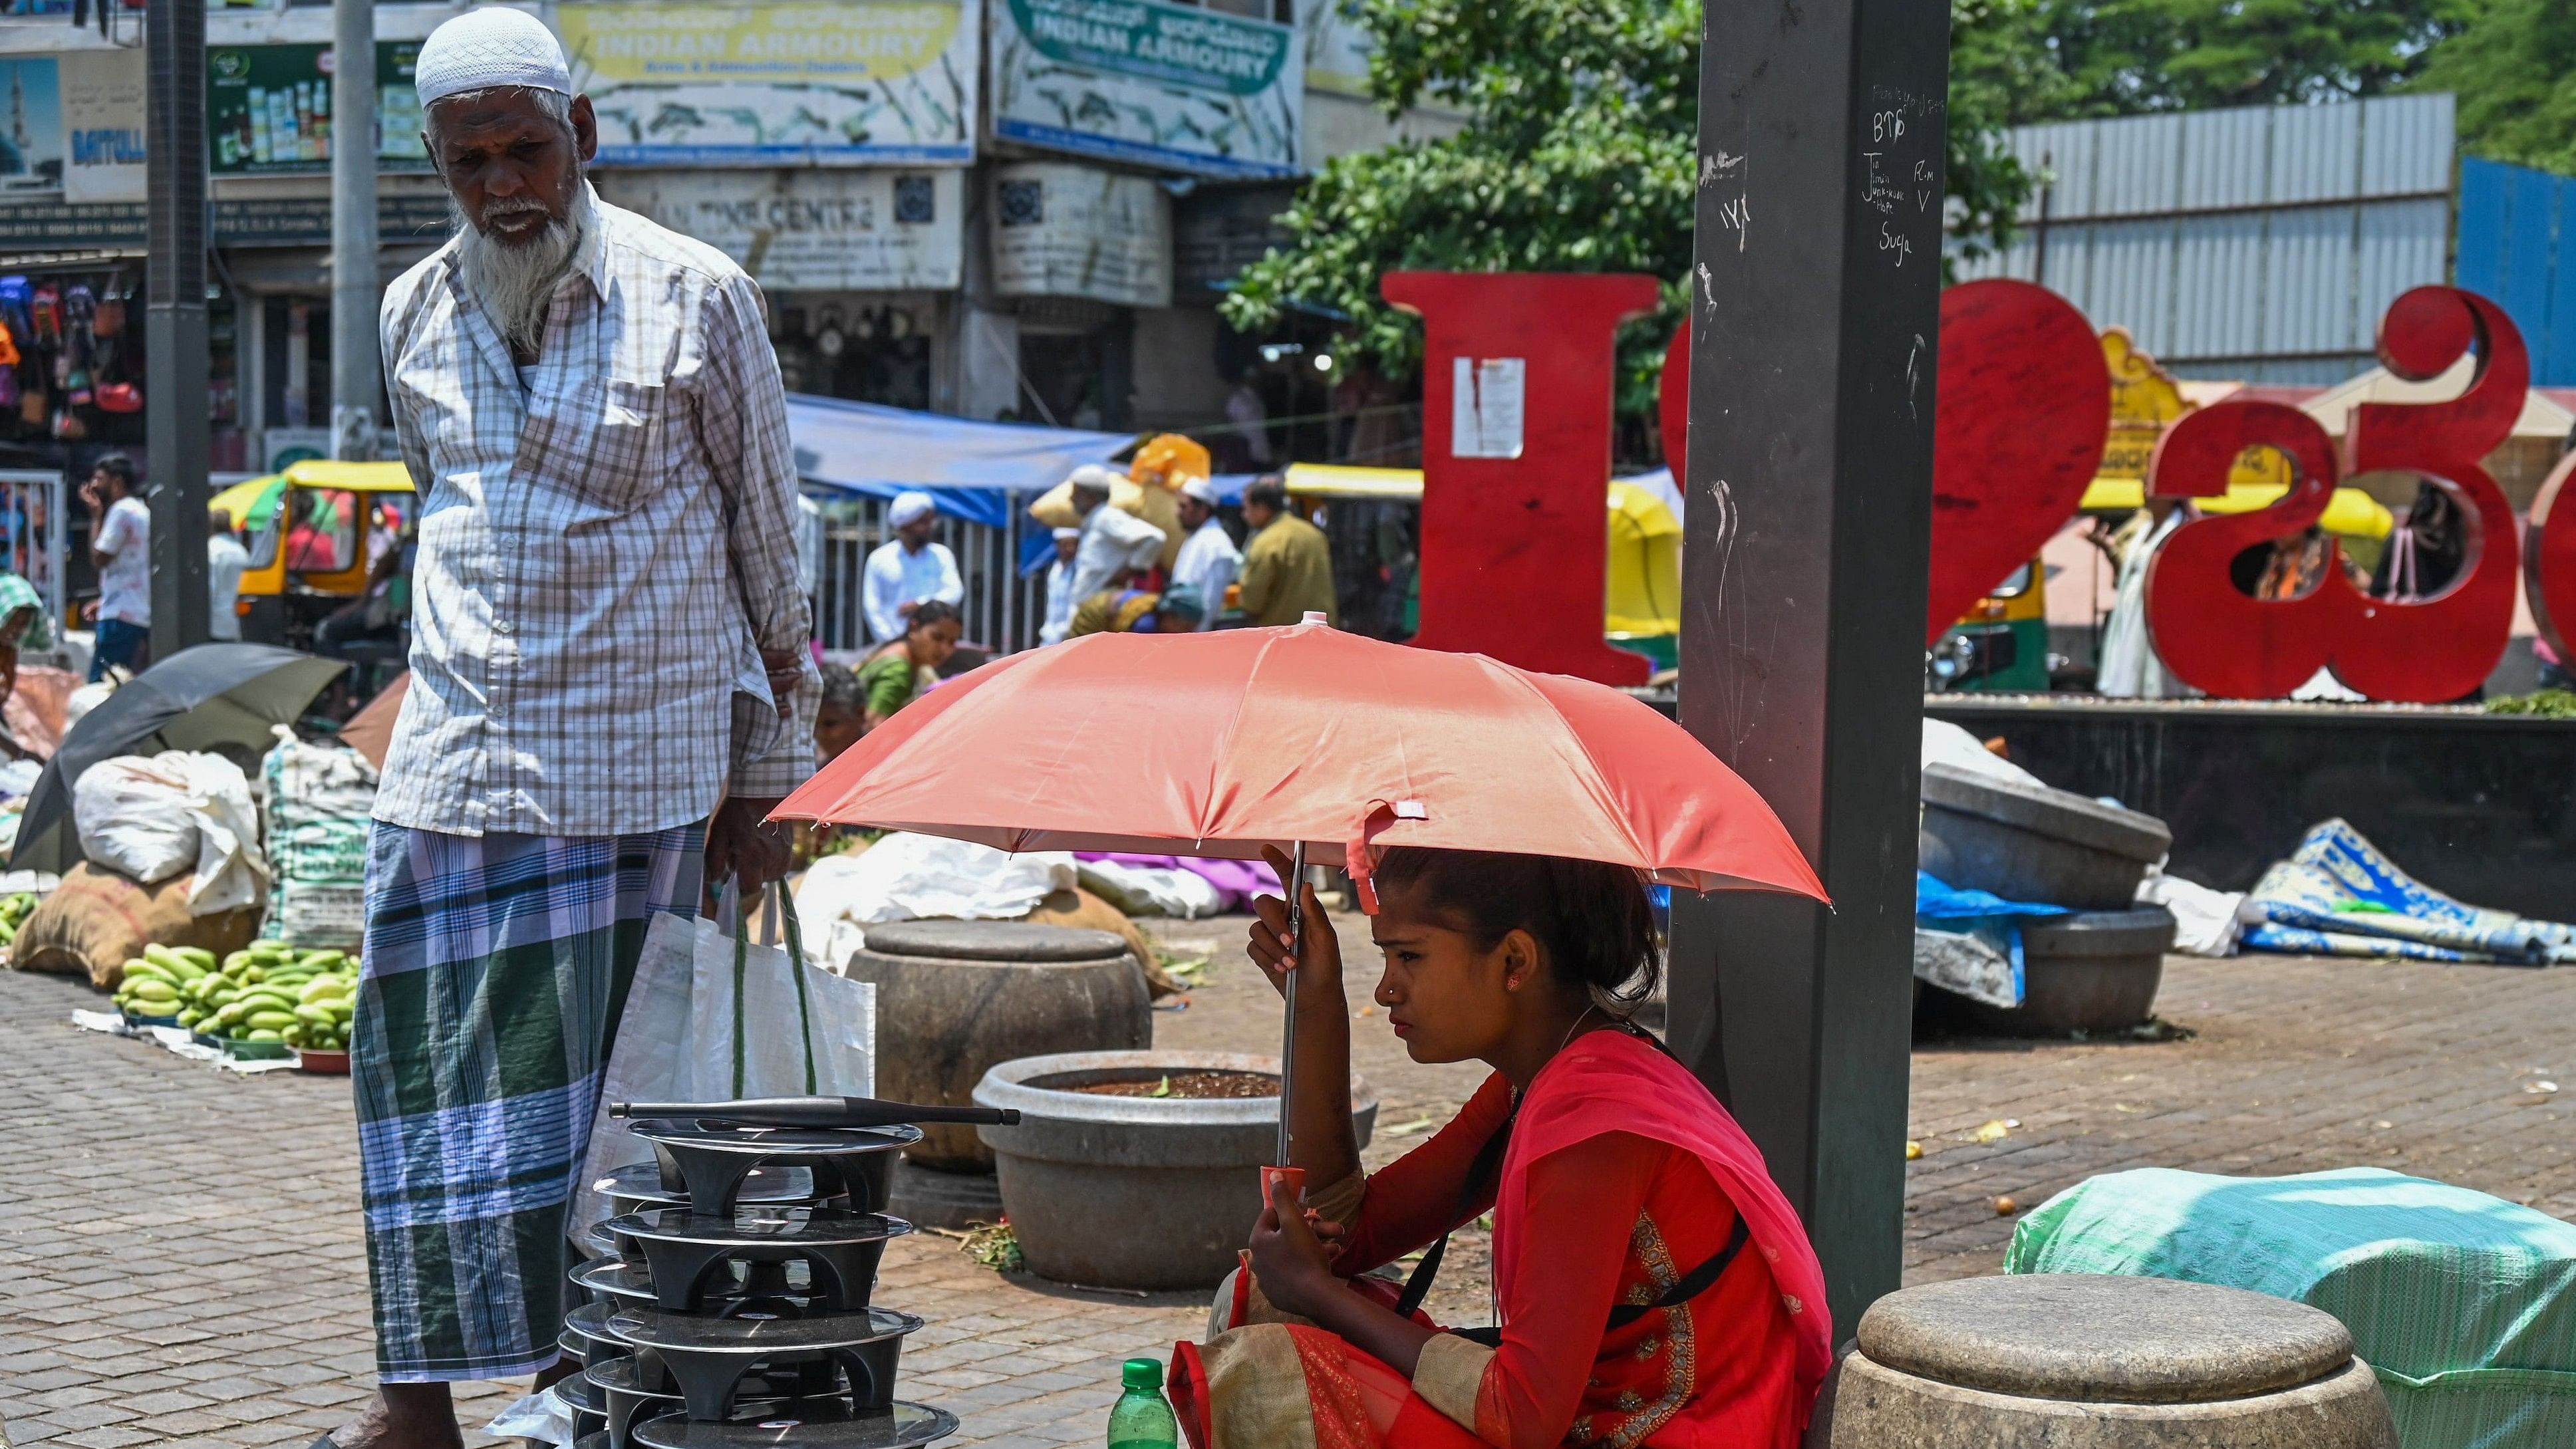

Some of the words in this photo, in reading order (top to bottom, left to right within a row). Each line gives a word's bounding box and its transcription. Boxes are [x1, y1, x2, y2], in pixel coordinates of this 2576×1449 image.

[597, 33, 726, 57] INDIAN
[739, 32, 929, 58] ARMOURY
[1030, 11, 1129, 53] INDIAN
[1135, 33, 1270, 80] ARMOURY
